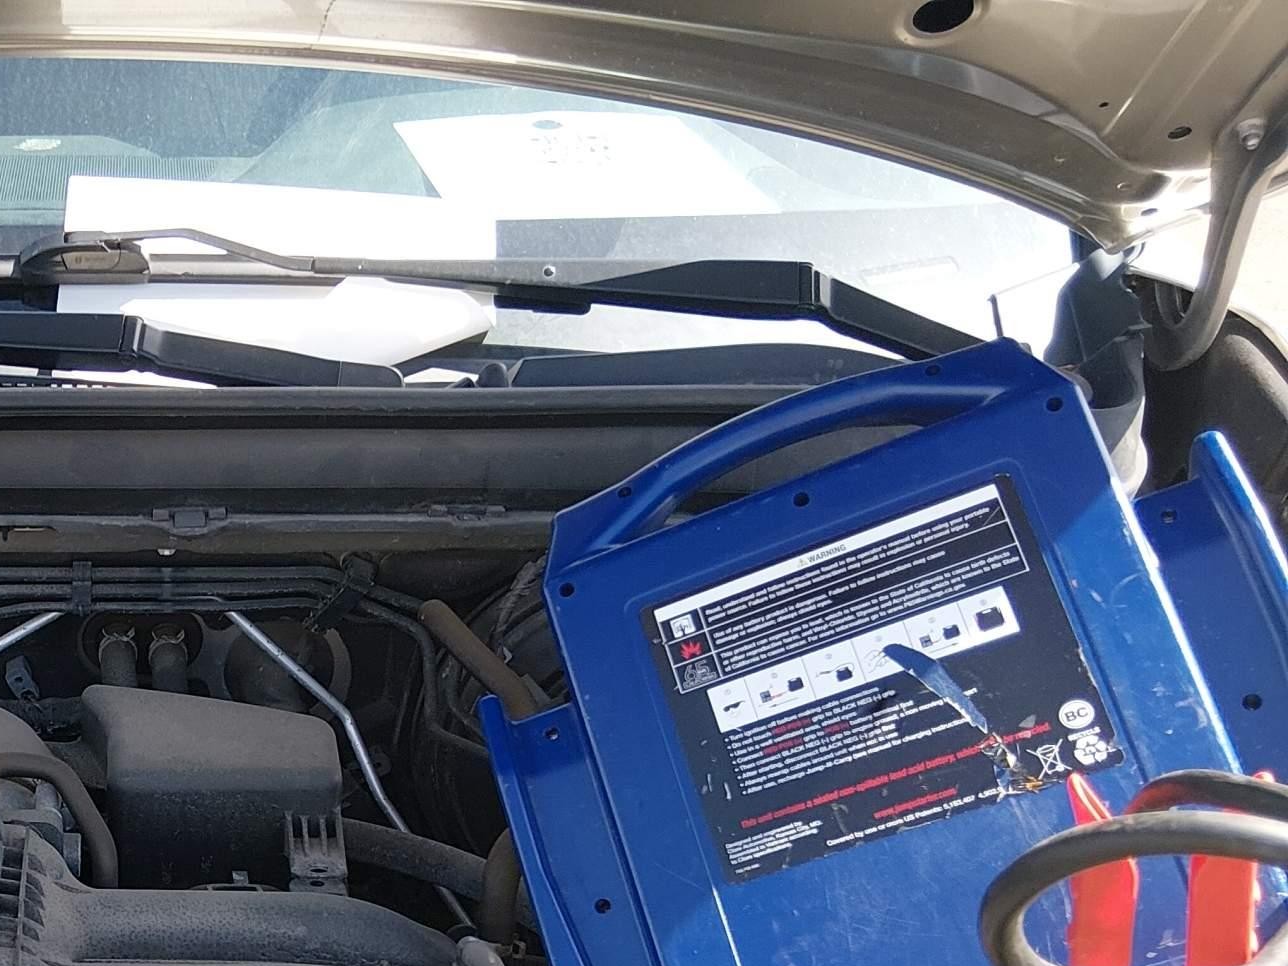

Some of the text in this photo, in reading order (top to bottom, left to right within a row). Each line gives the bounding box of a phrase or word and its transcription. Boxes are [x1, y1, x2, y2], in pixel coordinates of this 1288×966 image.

[806, 543, 846, 563] WARNING
[729, 732, 743, 741] Turn
[743, 724, 767, 737] ignition
[776, 713, 797, 725] before
[797, 705, 821, 718] making
[821, 699, 839, 710] cable
[839, 686, 879, 704] connections
[1064, 706, 1088, 722] BC
[931, 716, 969, 733] instruction
[1066, 725, 1101, 742] RECYCLE
[826, 833, 854, 846] Covered
[885, 818, 903, 827] more
[914, 805, 943, 818] Patents:
